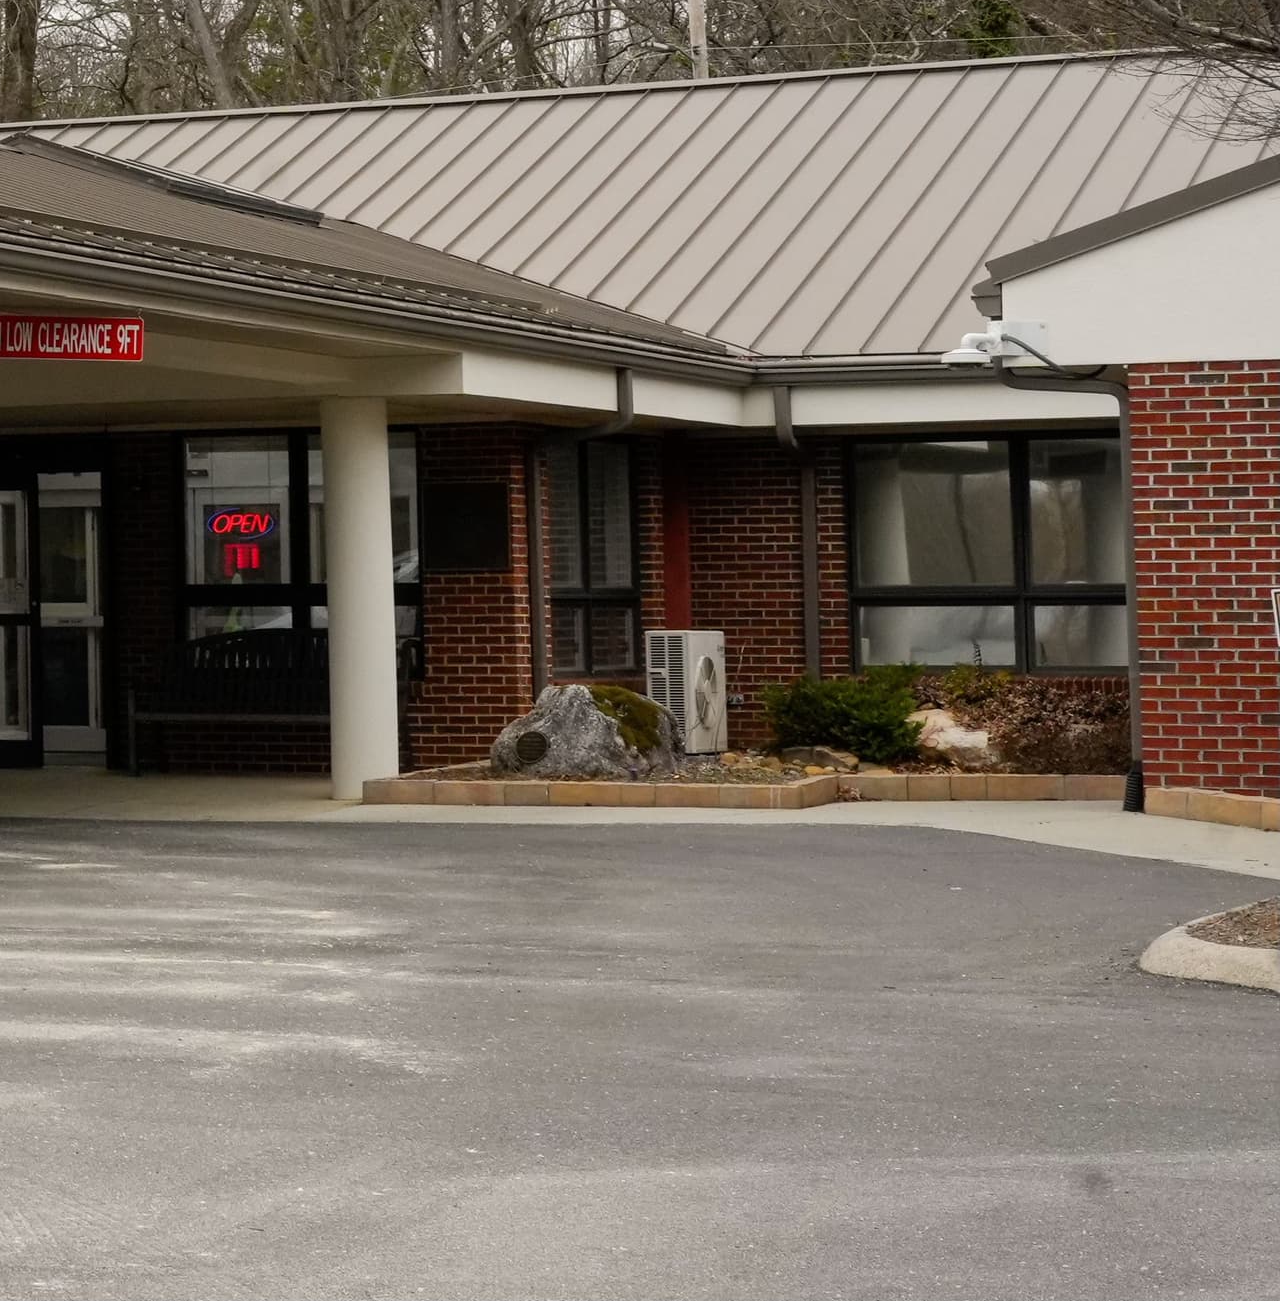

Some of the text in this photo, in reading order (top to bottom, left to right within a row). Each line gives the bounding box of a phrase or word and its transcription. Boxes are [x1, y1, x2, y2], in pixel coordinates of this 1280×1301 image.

[6, 321, 33, 353] LOW
[38, 322, 112, 355] CLEARANCE
[116, 324, 140, 355] 9FT
[211, 512, 271, 534] OPEN
